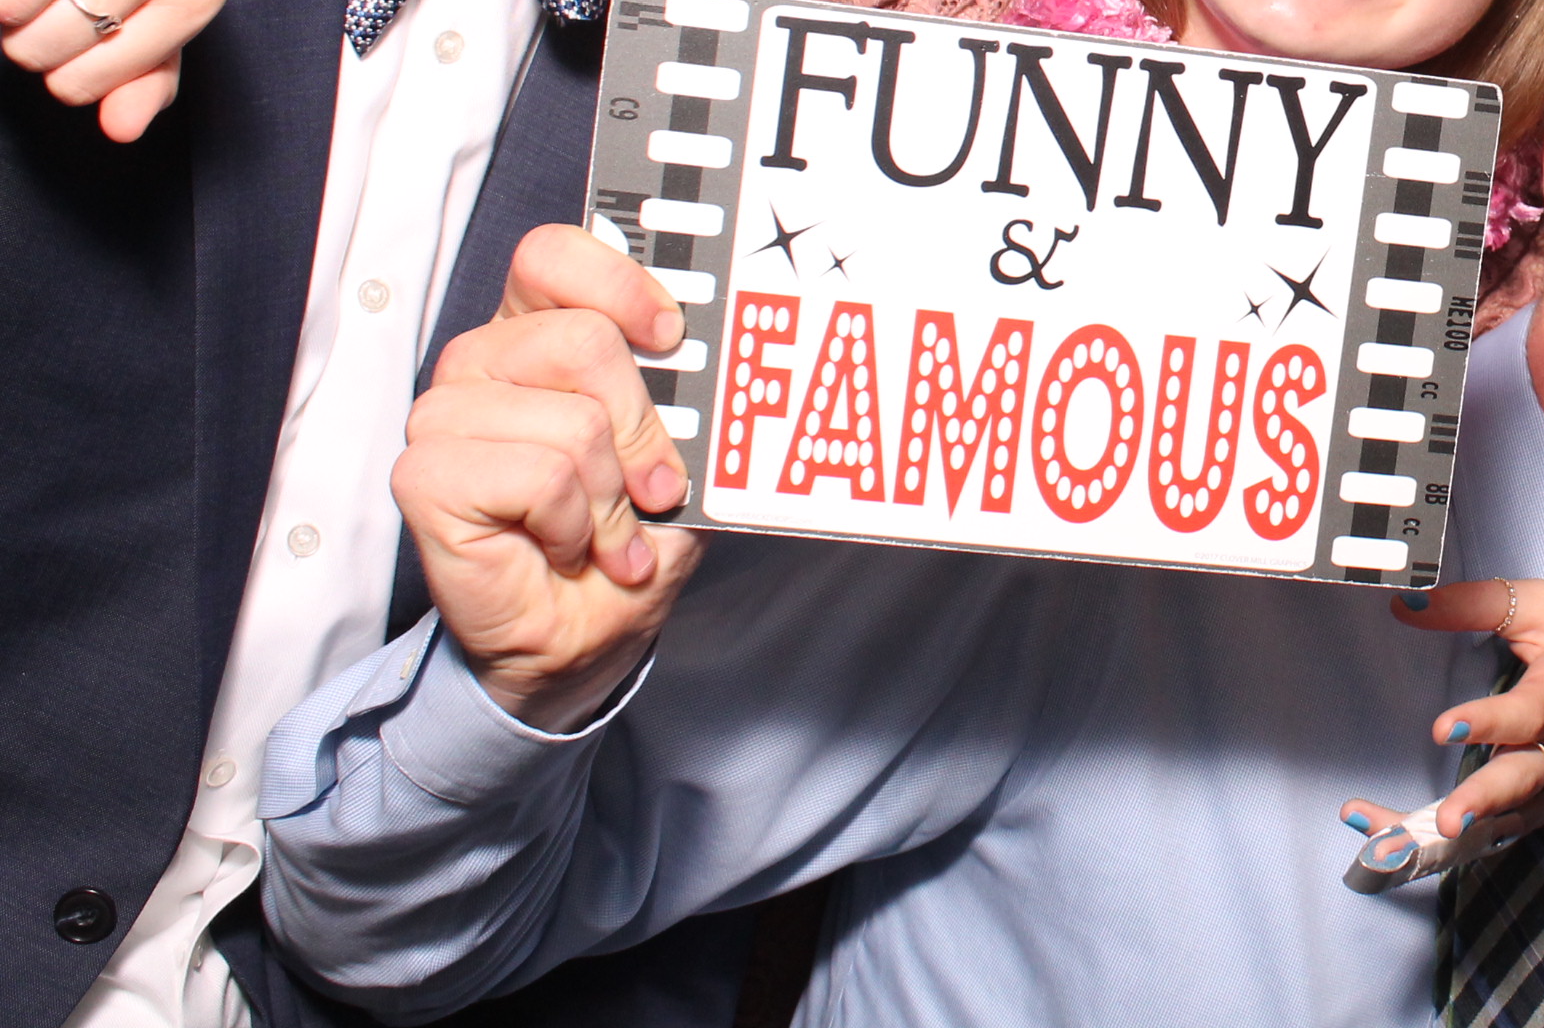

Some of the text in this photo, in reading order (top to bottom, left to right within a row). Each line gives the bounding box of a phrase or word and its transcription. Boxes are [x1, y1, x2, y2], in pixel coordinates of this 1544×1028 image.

[759, 15, 1369, 231] FUNNY
[989, 218, 1080, 291] &
[713, 289, 1328, 542] FAMOUS
